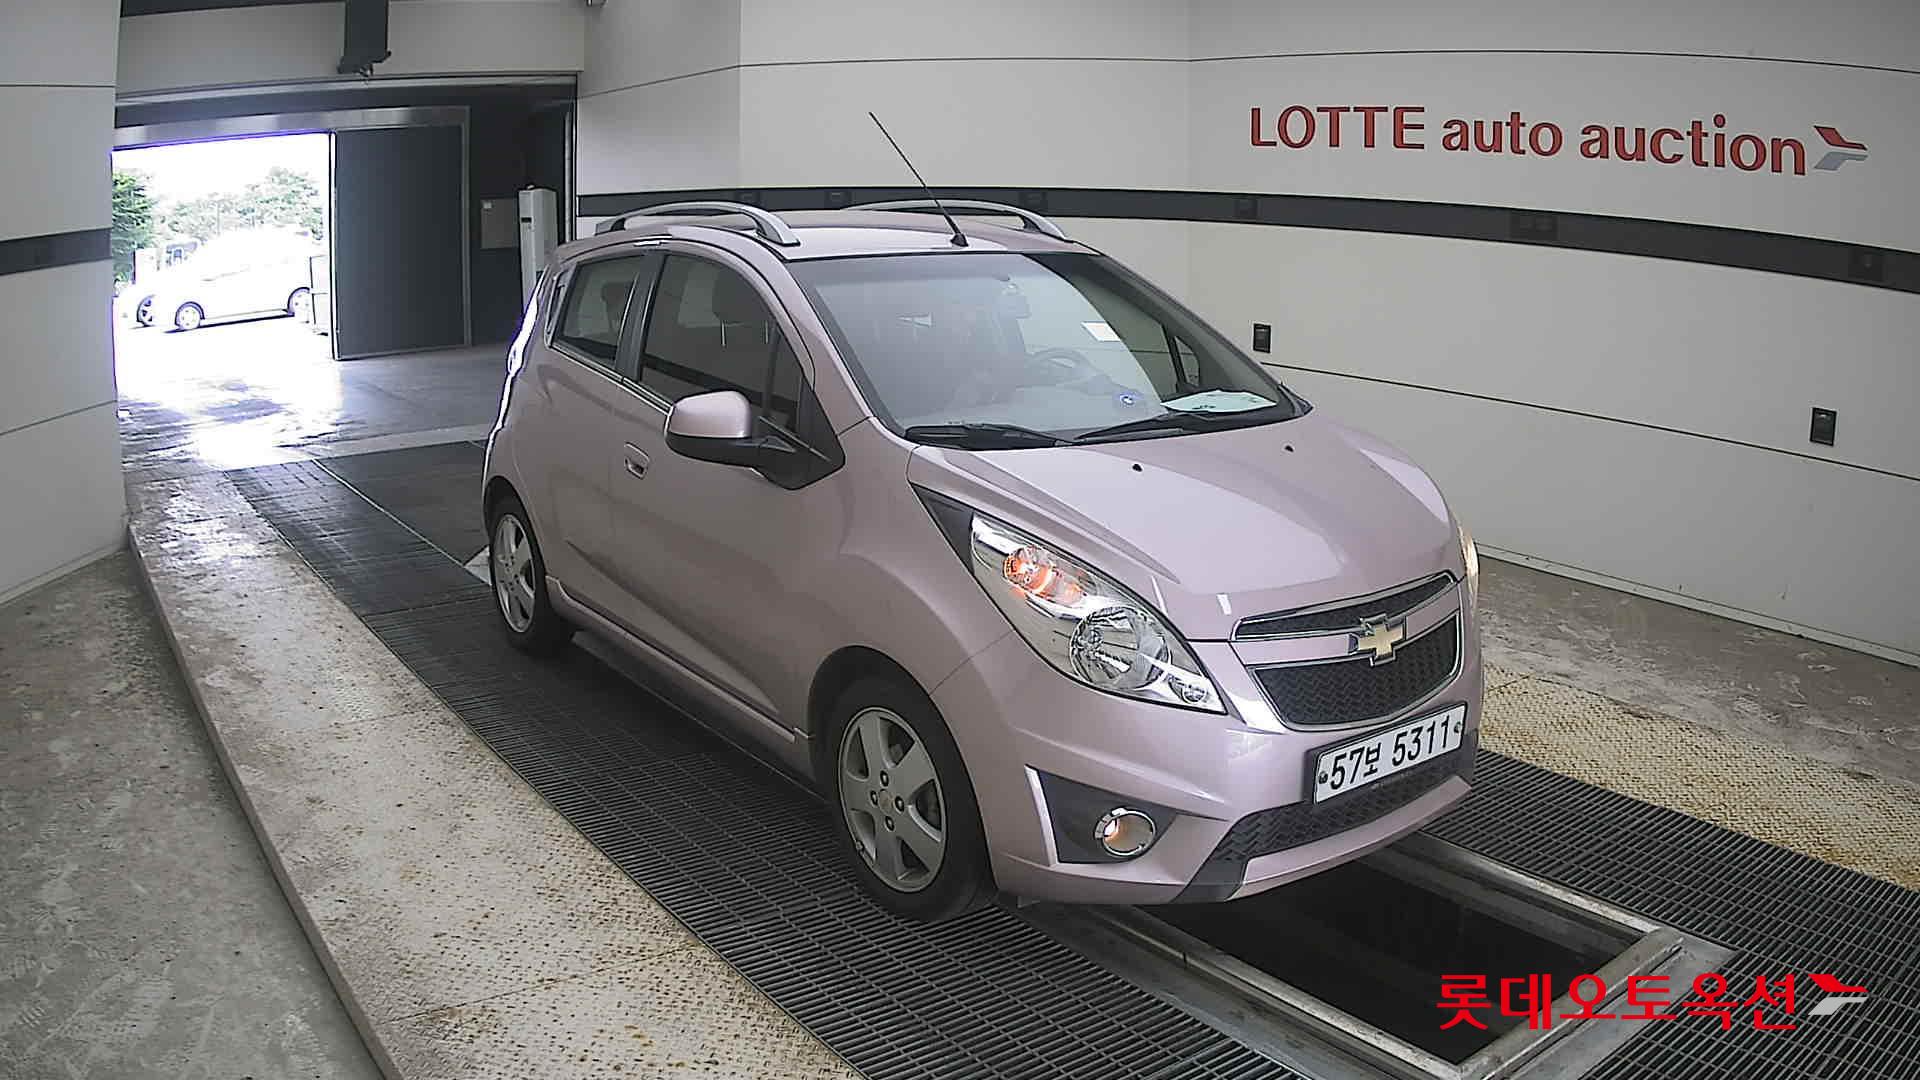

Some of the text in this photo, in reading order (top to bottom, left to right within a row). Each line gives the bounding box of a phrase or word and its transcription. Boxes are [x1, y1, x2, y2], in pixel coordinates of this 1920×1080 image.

[1250, 105, 1807, 176] LOTTE auto auction
[1330, 715, 1451, 790] 57보 5311
